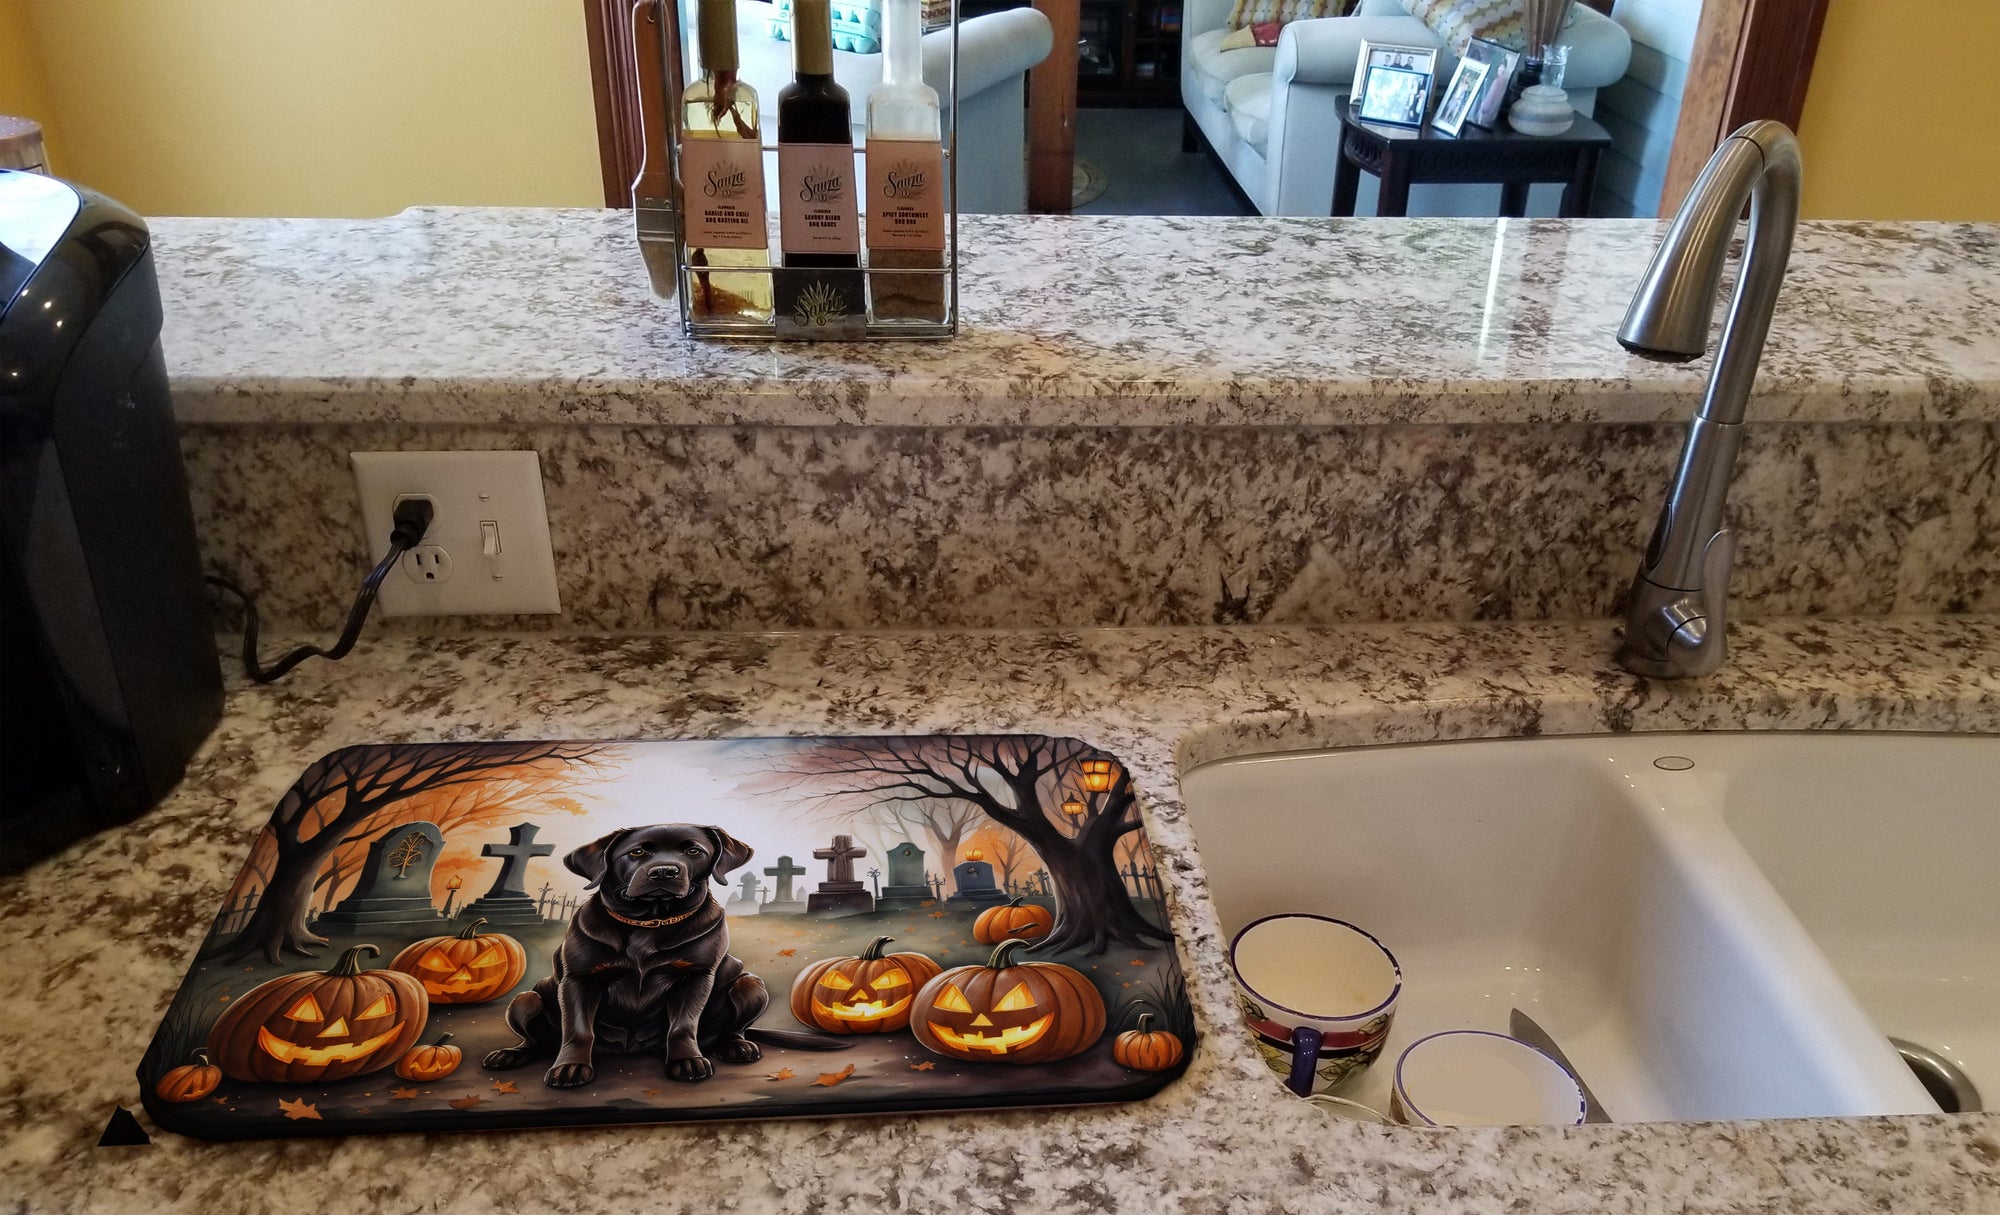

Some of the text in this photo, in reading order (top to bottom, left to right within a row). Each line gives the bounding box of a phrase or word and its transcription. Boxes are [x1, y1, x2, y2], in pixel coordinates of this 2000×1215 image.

[704, 170, 745, 197] Sauza
[800, 175, 841, 202] Sauza
[883, 171, 924, 198] Sauza
